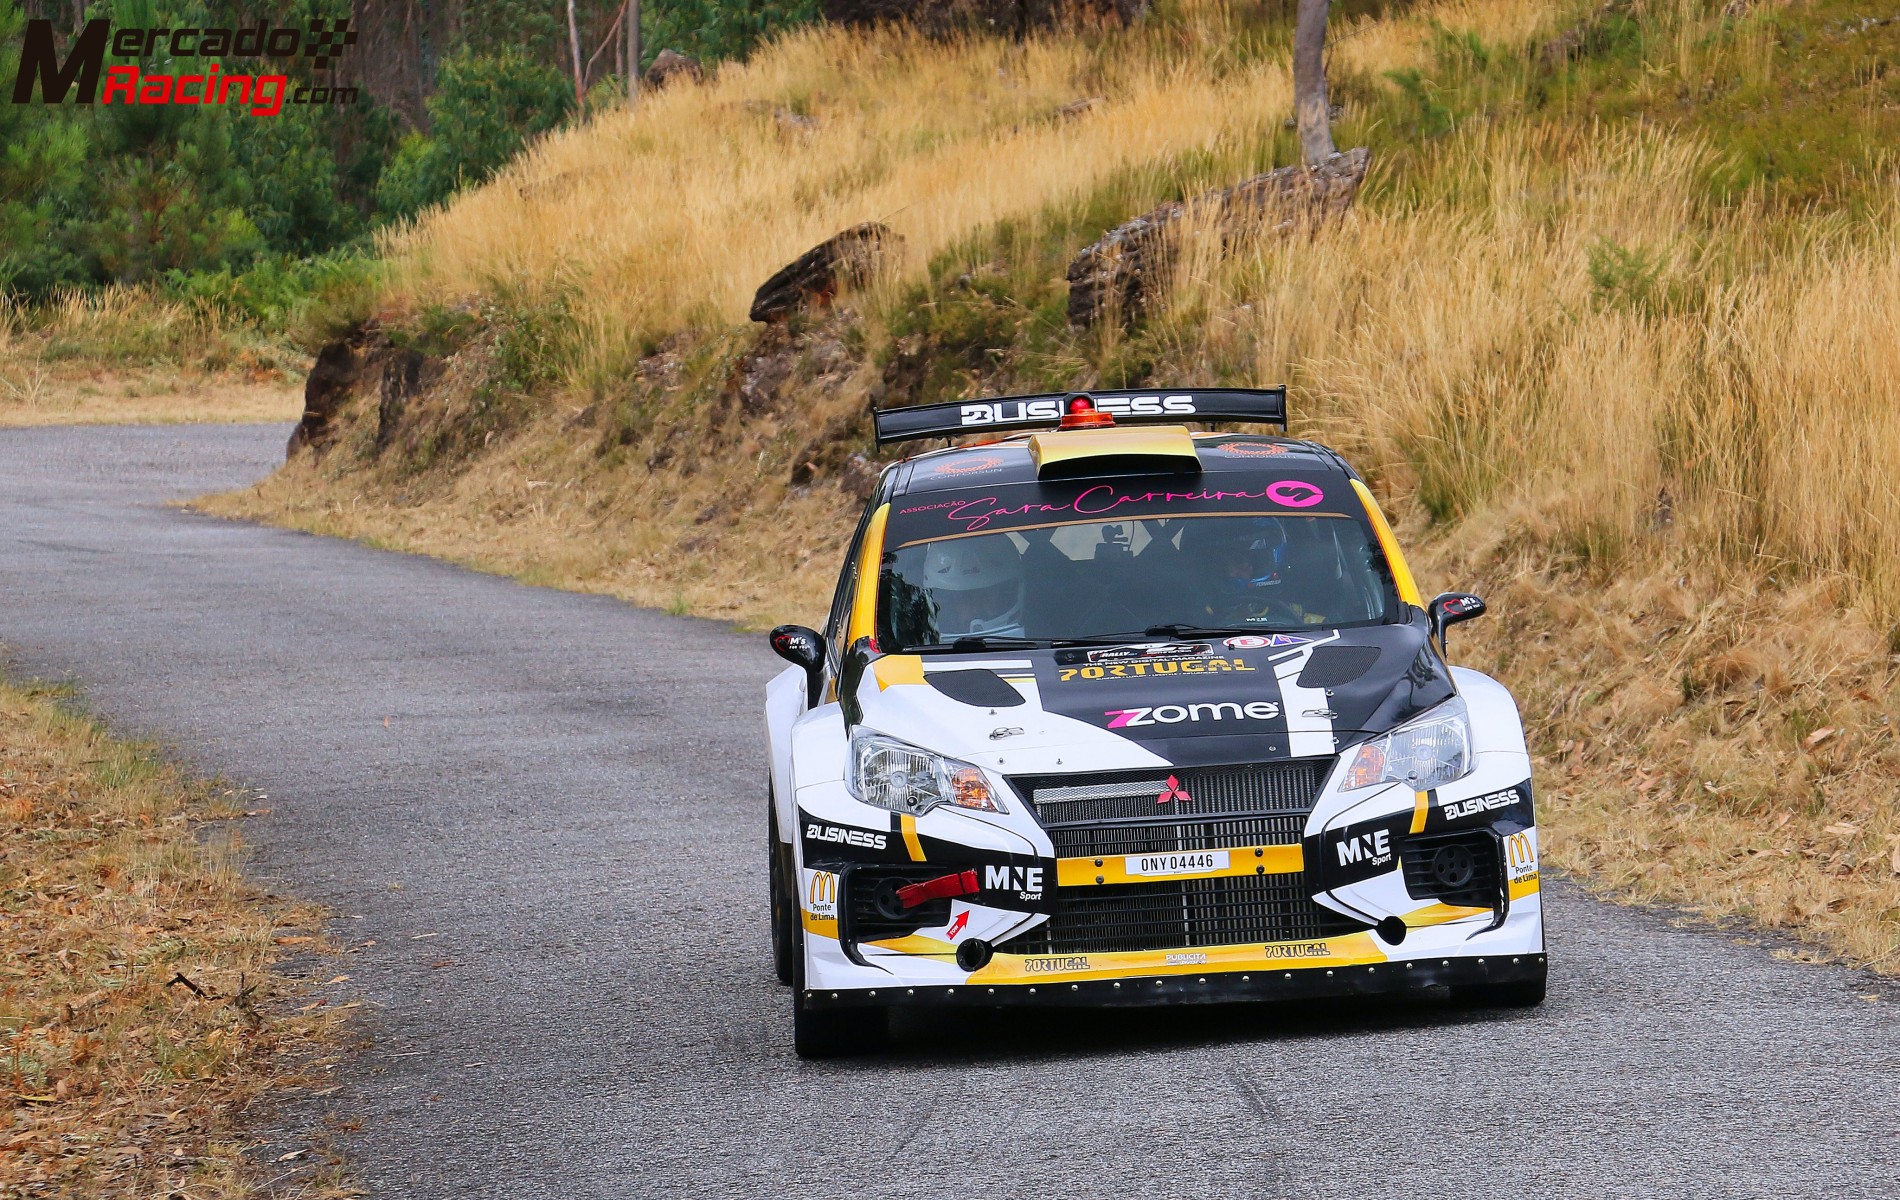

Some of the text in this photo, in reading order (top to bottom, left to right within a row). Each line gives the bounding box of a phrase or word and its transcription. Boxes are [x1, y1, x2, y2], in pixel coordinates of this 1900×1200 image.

[960, 395, 1197, 426] BUSIESS
[898, 484, 1265, 531] ASSOCIAÇÃO Sara Carreira
[789, 636, 807, 645] M's
[1444, 789, 1521, 821] BUSINESS
[805, 823, 888, 850] BUSINESS
[1371, 852, 1393, 867] Sport
[1515, 864, 1534, 874] Ponte
[1513, 871, 1539, 885] de Lima
[1019, 891, 1043, 901] Sport
[812, 903, 832, 912] Ponte
[809, 911, 835, 921] de Lima
